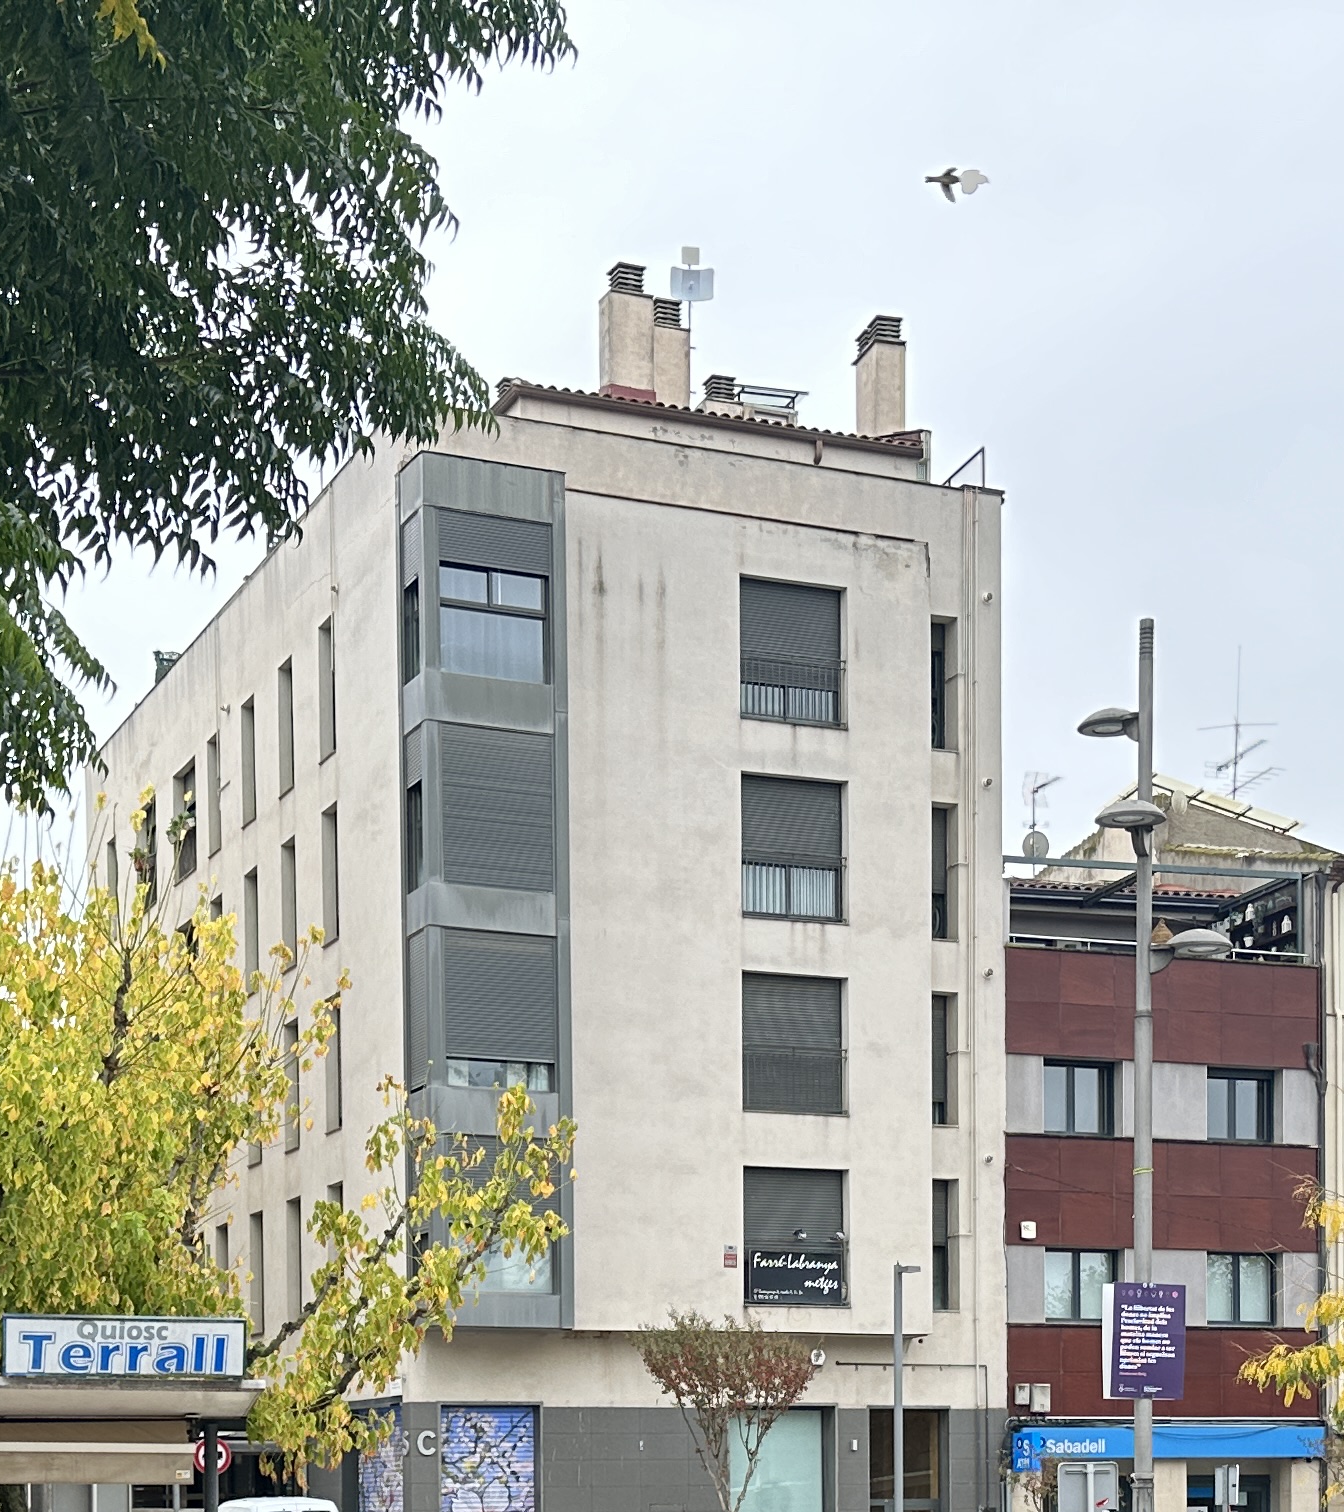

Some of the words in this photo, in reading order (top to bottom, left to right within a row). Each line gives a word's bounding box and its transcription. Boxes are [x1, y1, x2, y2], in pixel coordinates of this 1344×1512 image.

[804, 1276, 839, 1294] metges
[76, 1319, 169, 1342] Quiosc
[19, 1331, 229, 1374] Terrall
[1046, 1438, 1106, 1454] Sabadell
